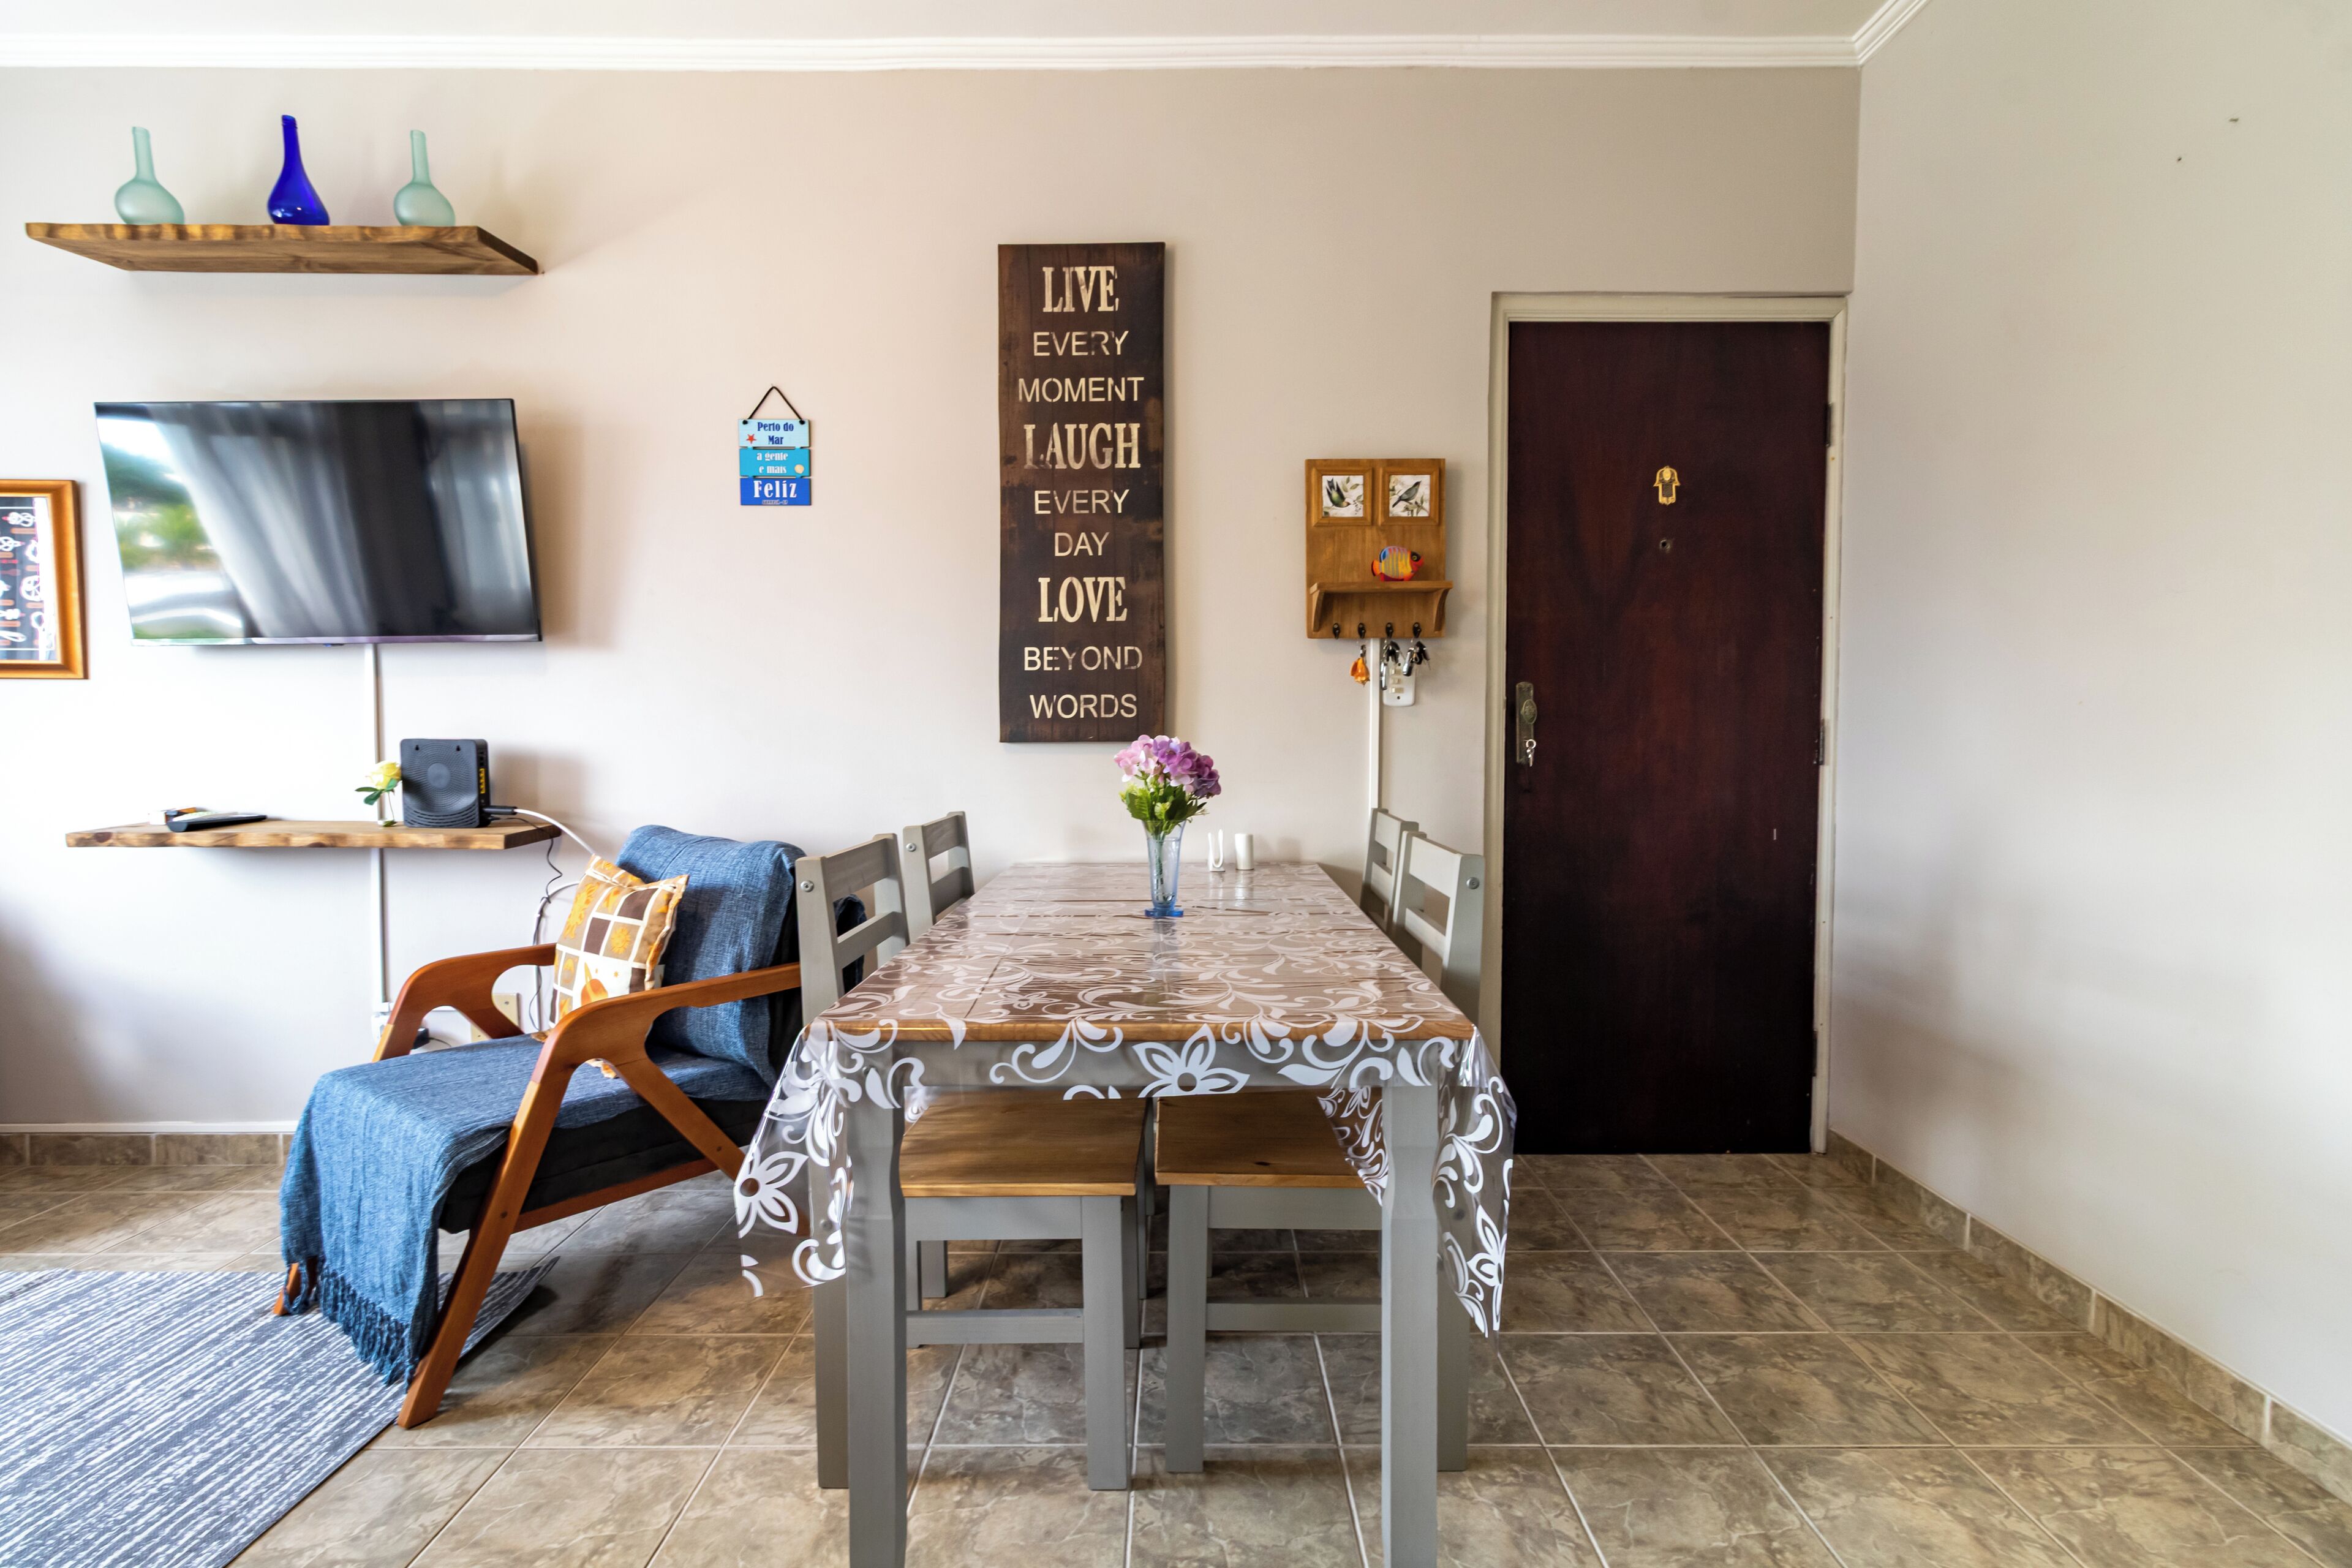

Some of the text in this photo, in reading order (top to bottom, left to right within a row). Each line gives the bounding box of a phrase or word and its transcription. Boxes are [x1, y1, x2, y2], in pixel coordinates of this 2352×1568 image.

[1042, 266, 1119, 312] LIVE
[1033, 331, 1129, 356] EVERY
[1018, 377, 1144, 402] MOMENT
[757, 421, 794, 431] Perto do
[768, 435, 784, 445] Mar
[1023, 422, 1141, 469] LAUGH
[764, 451, 788, 461] gente
[767, 465, 787, 473] mais
[753, 480, 797, 498] Feliz
[1034, 489, 1129, 514] EVERY
[1054, 532, 1109, 556] DAY
[1038, 576, 1128, 622] LOVE
[1024, 646, 1142, 671] BEYOND
[1030, 694, 1137, 718] WORDS
